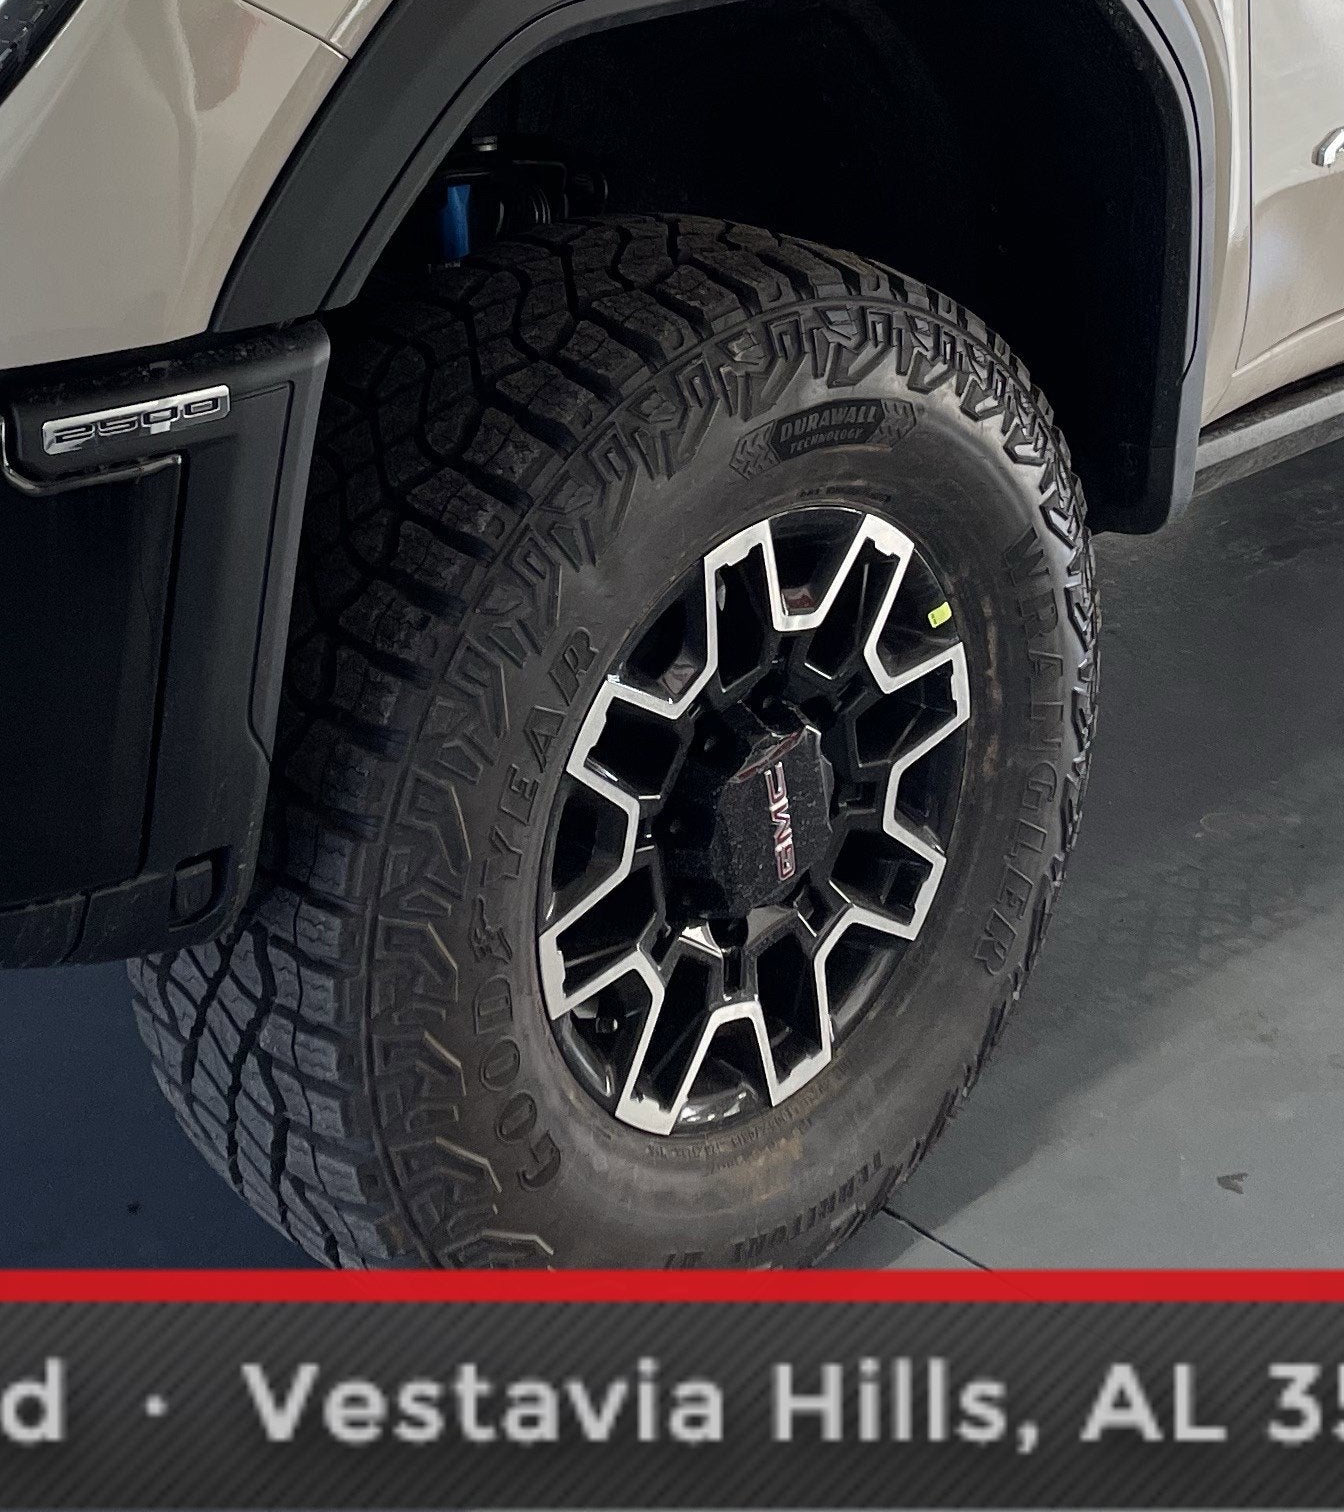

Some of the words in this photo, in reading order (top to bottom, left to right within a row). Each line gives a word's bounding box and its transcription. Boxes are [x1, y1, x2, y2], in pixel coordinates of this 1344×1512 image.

[53, 396, 223, 444] 2500
[779, 404, 879, 444] DURAWALL
[972, 525, 1065, 977] WRANGLER
[763, 760, 797, 882] GMC
